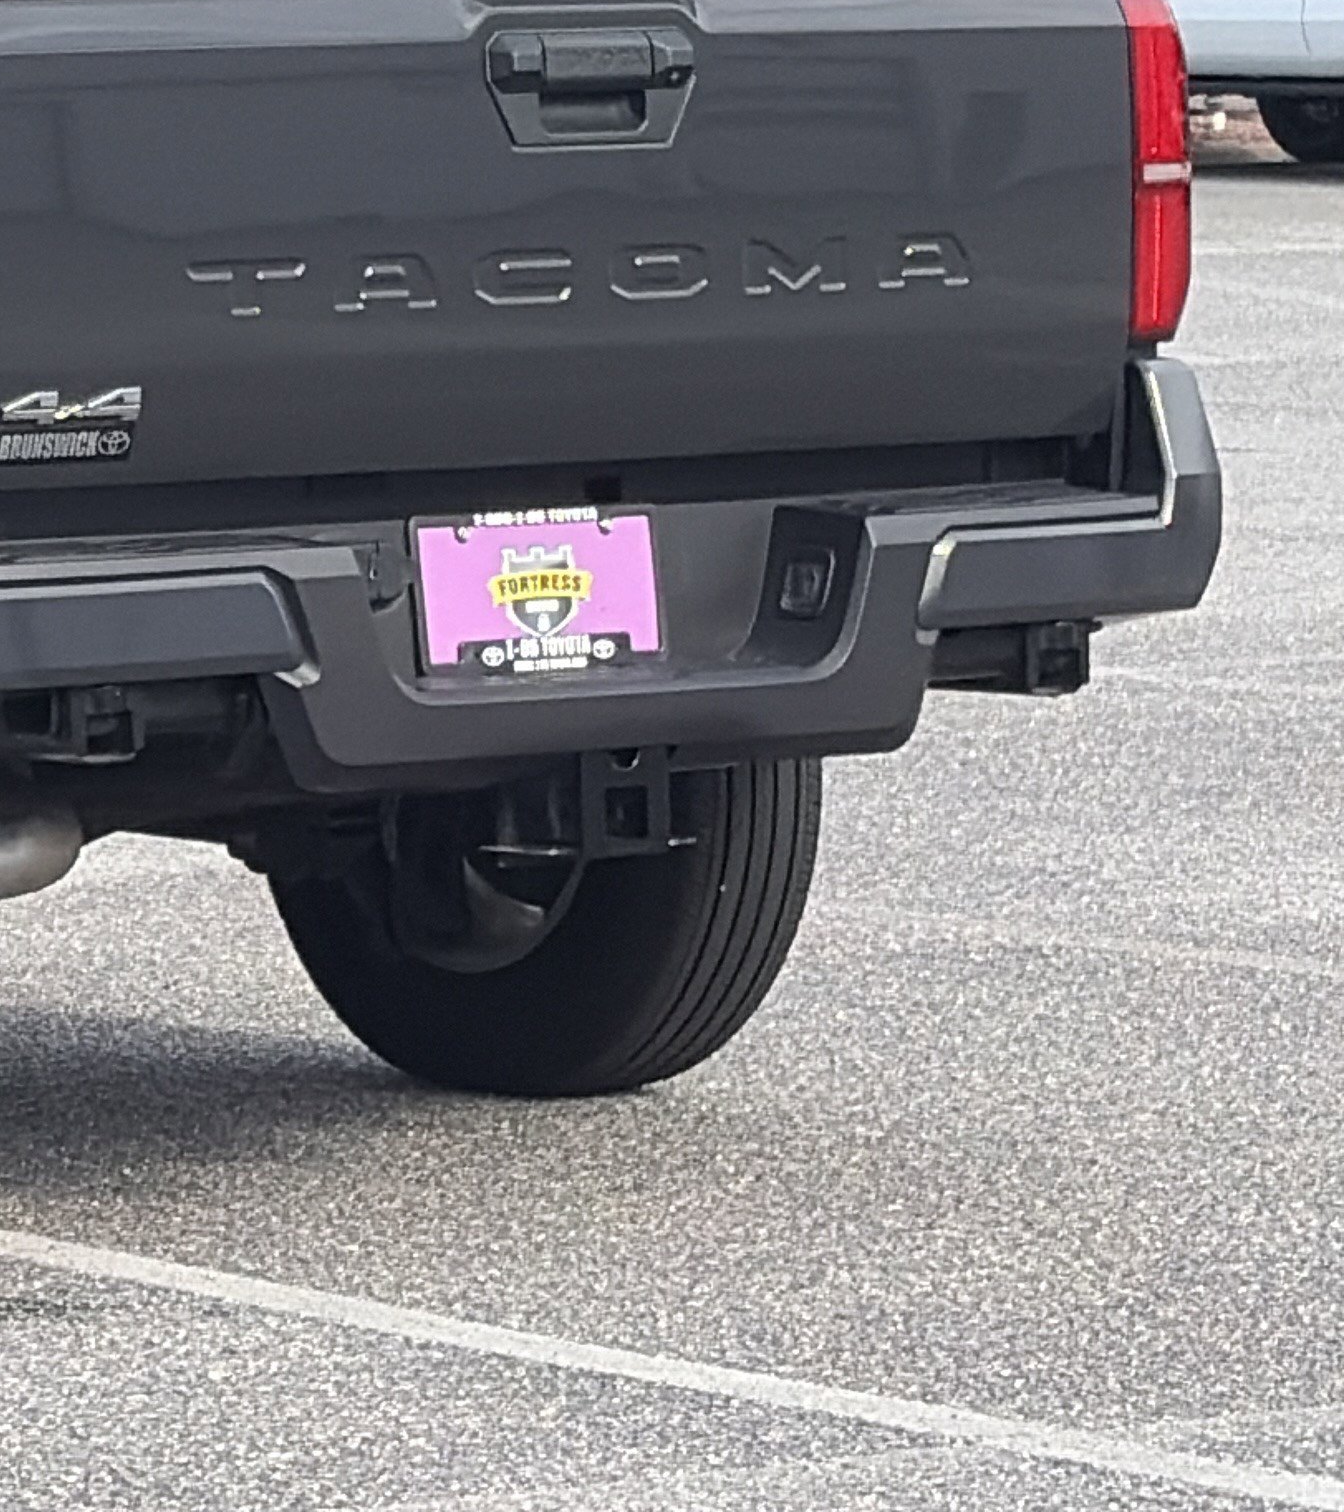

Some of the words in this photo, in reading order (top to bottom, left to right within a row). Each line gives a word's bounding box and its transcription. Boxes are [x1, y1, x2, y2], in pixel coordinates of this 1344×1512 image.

[186, 231, 972, 316] TACOMA
[547, 506, 598, 523] TOYOTA
[496, 573, 583, 597] FORTRESS
[540, 635, 591, 656] TOYOTA
